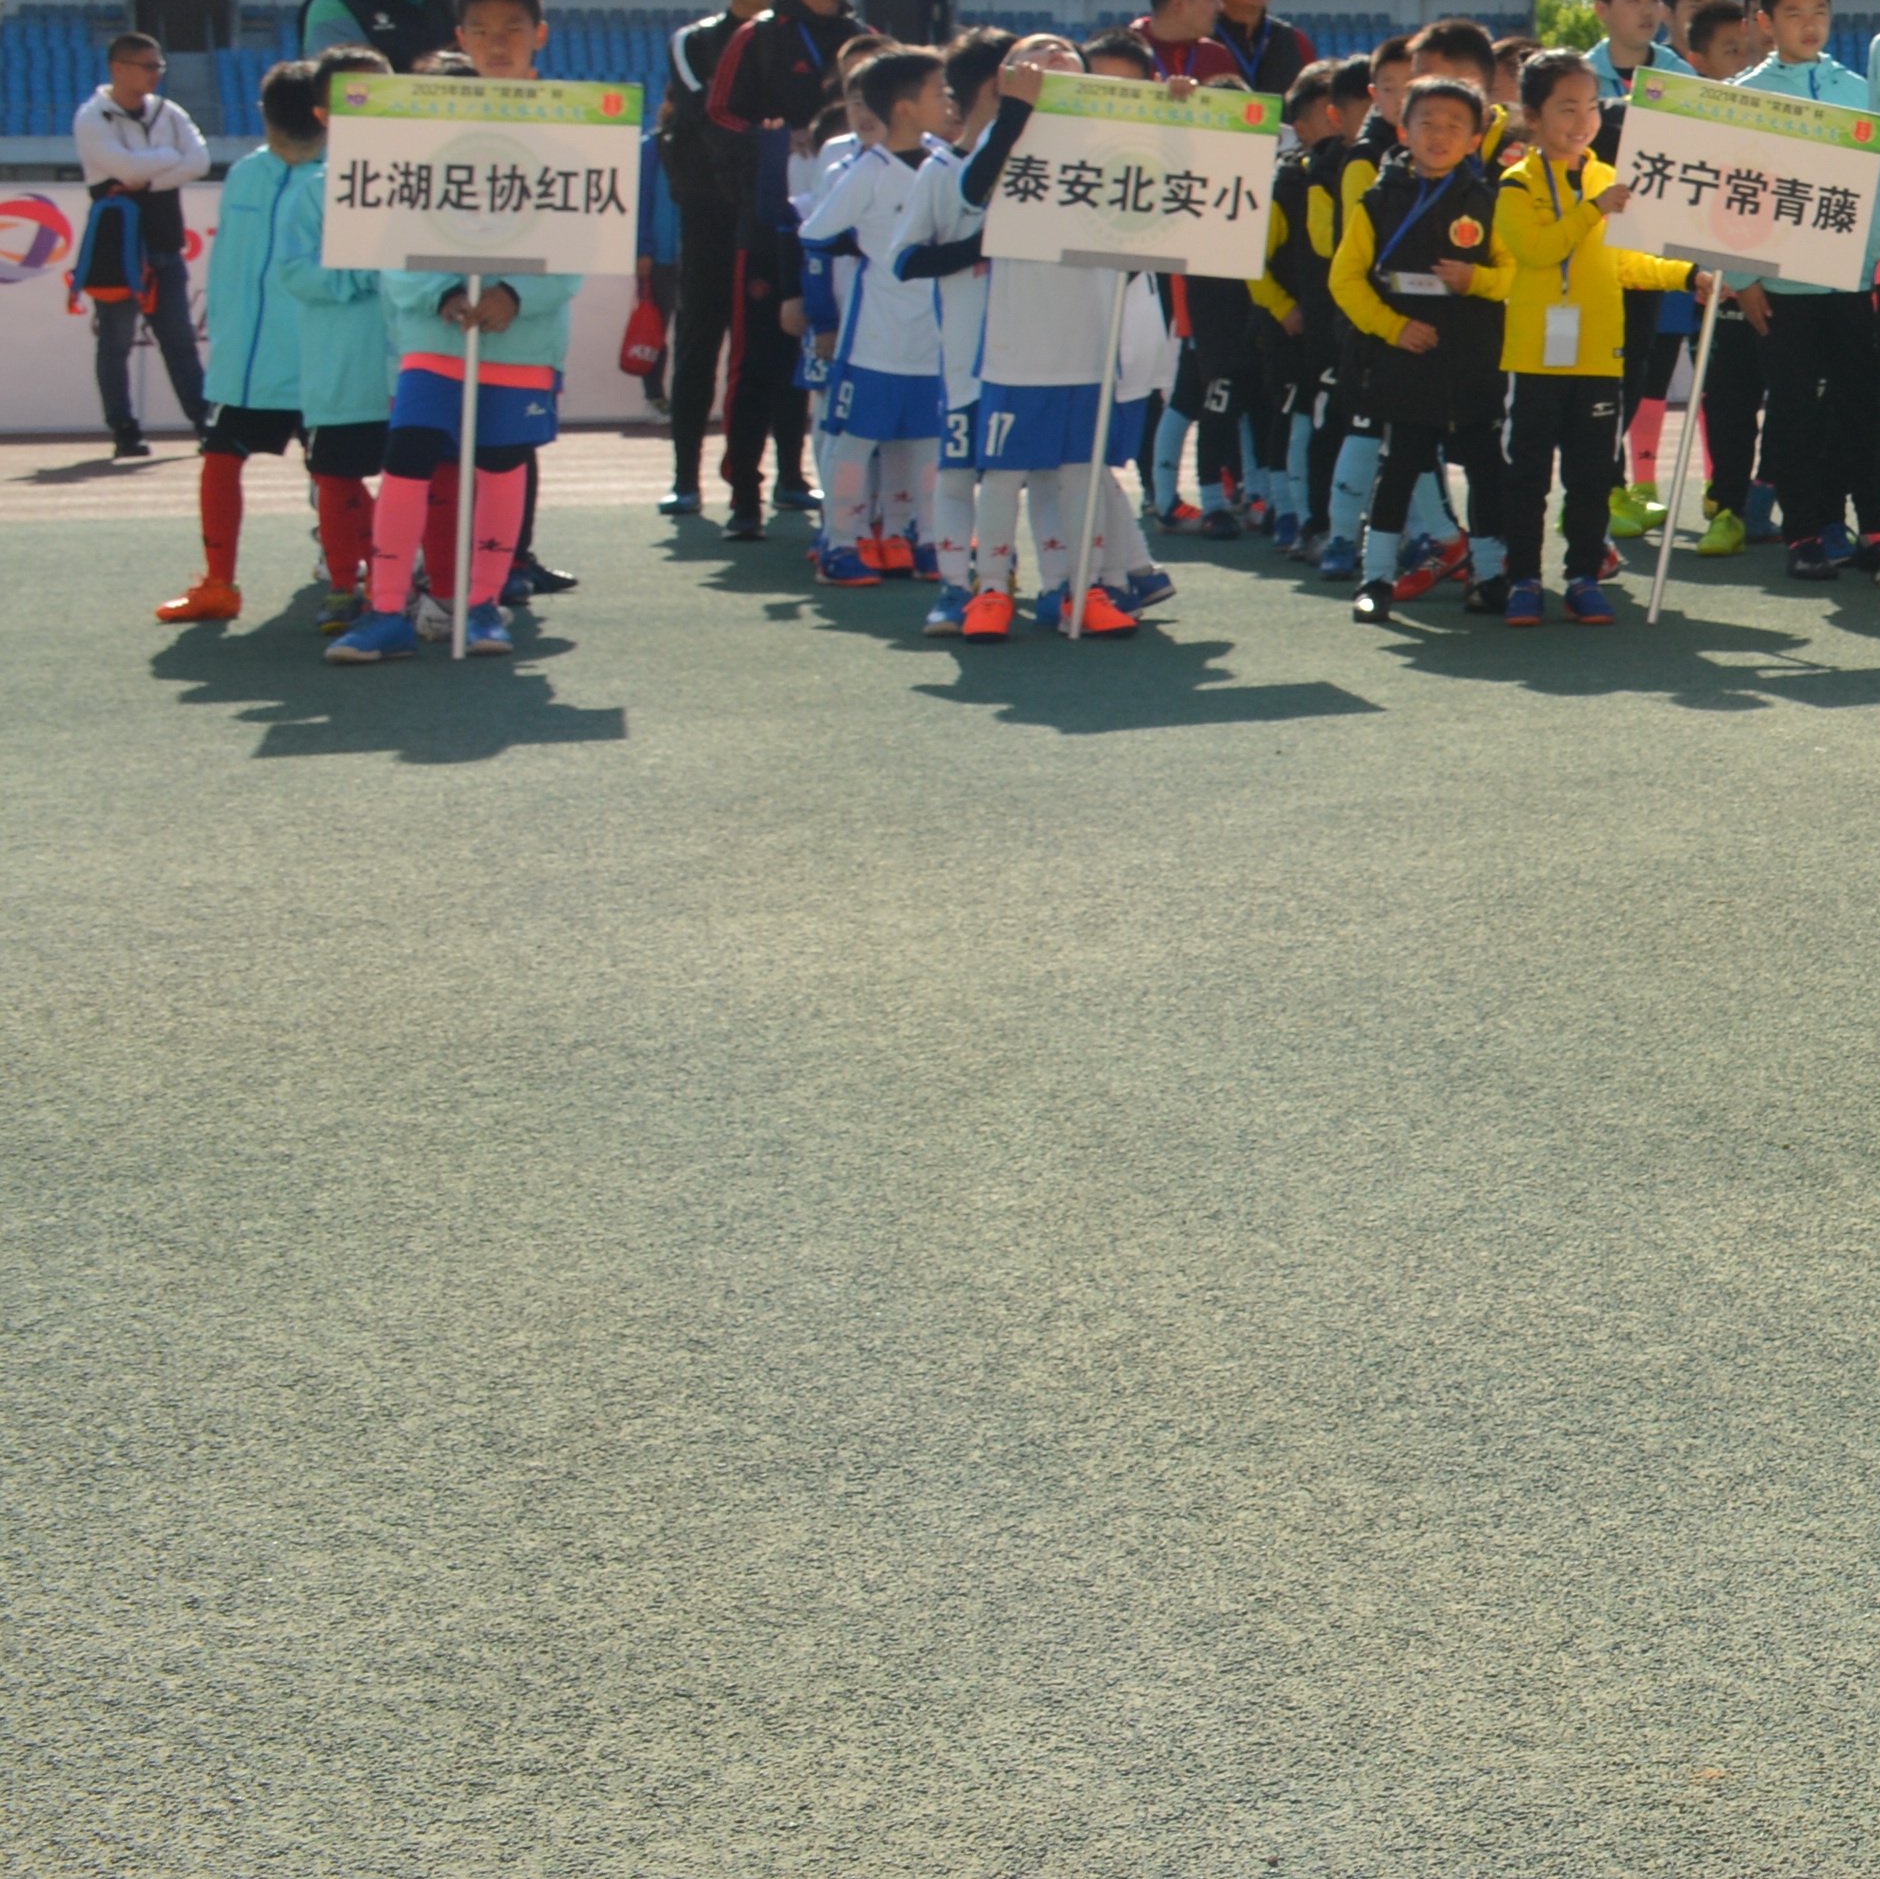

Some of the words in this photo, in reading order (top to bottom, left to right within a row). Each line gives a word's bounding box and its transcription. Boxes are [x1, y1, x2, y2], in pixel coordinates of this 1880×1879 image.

[337, 160, 628, 216] 北湖足协红队
[1003, 154, 1259, 222] 泰安北实小
[1629, 150, 1861, 234] 济宁常青藤
[835, 381, 855, 419] 9
[945, 413, 969, 458] 3
[985, 411, 1017, 457] 17
